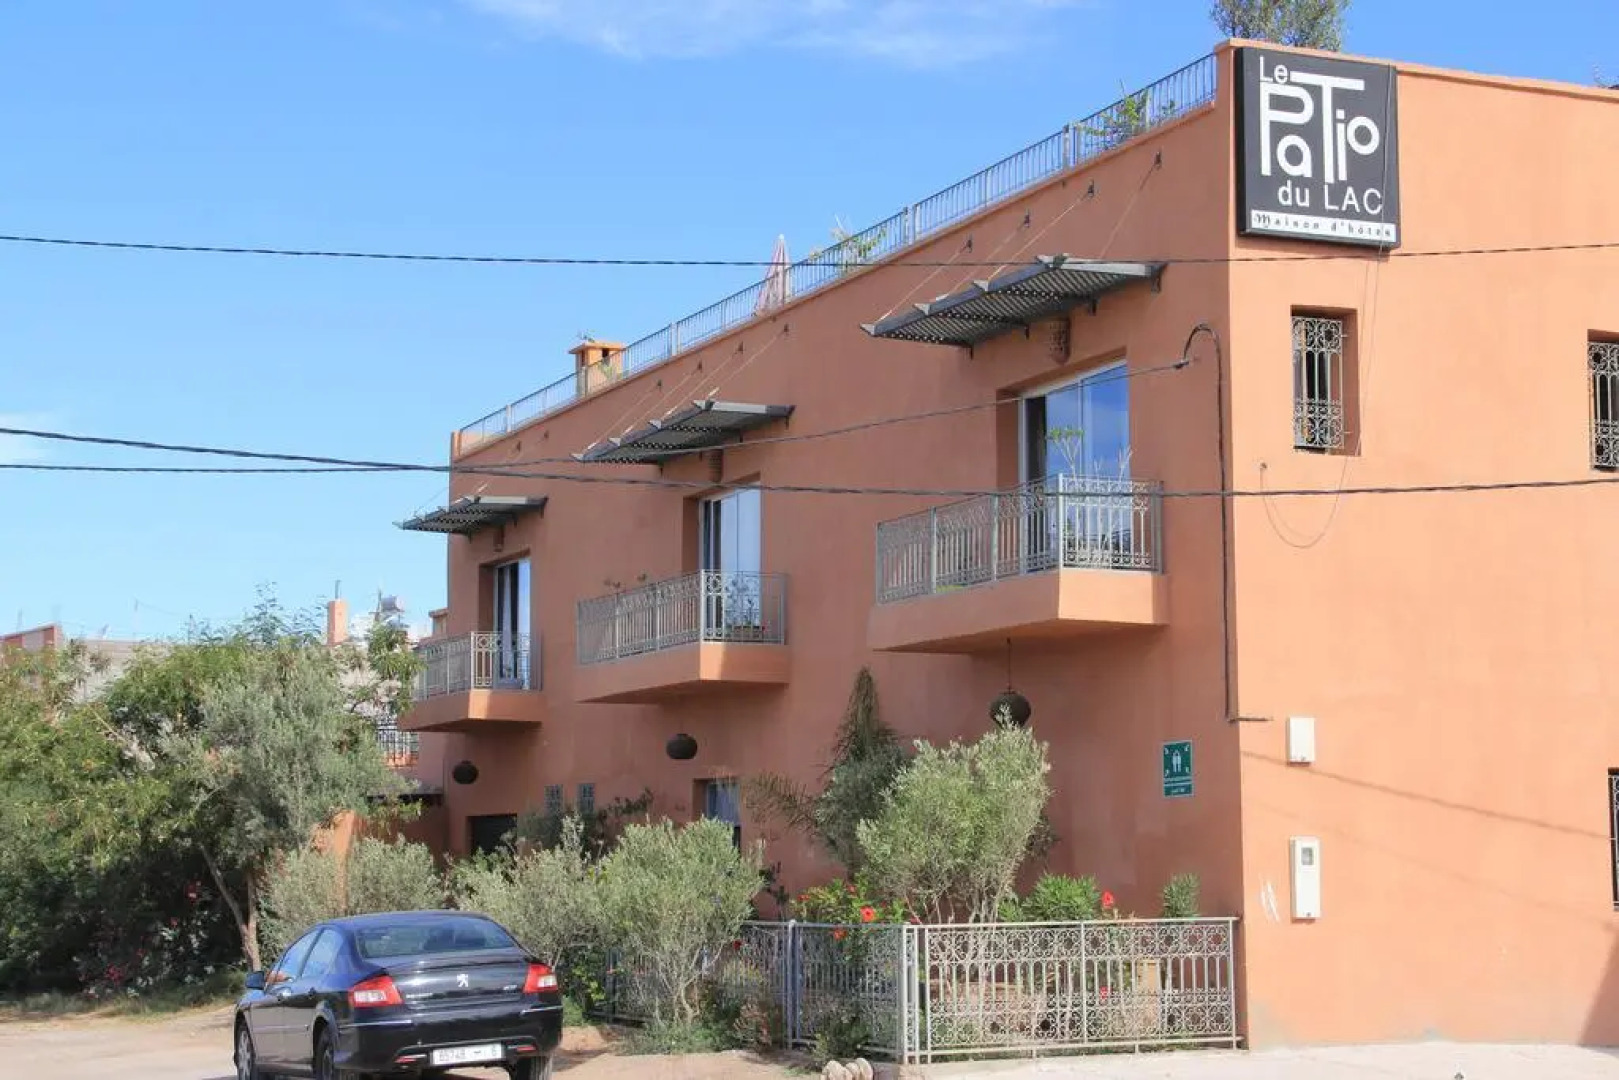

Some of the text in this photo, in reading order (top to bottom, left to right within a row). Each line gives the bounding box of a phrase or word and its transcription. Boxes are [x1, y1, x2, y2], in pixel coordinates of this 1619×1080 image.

[1259, 56, 1289, 85] Le
[1278, 180, 1383, 215] du LAC
[1254, 213, 1319, 229] Maison
